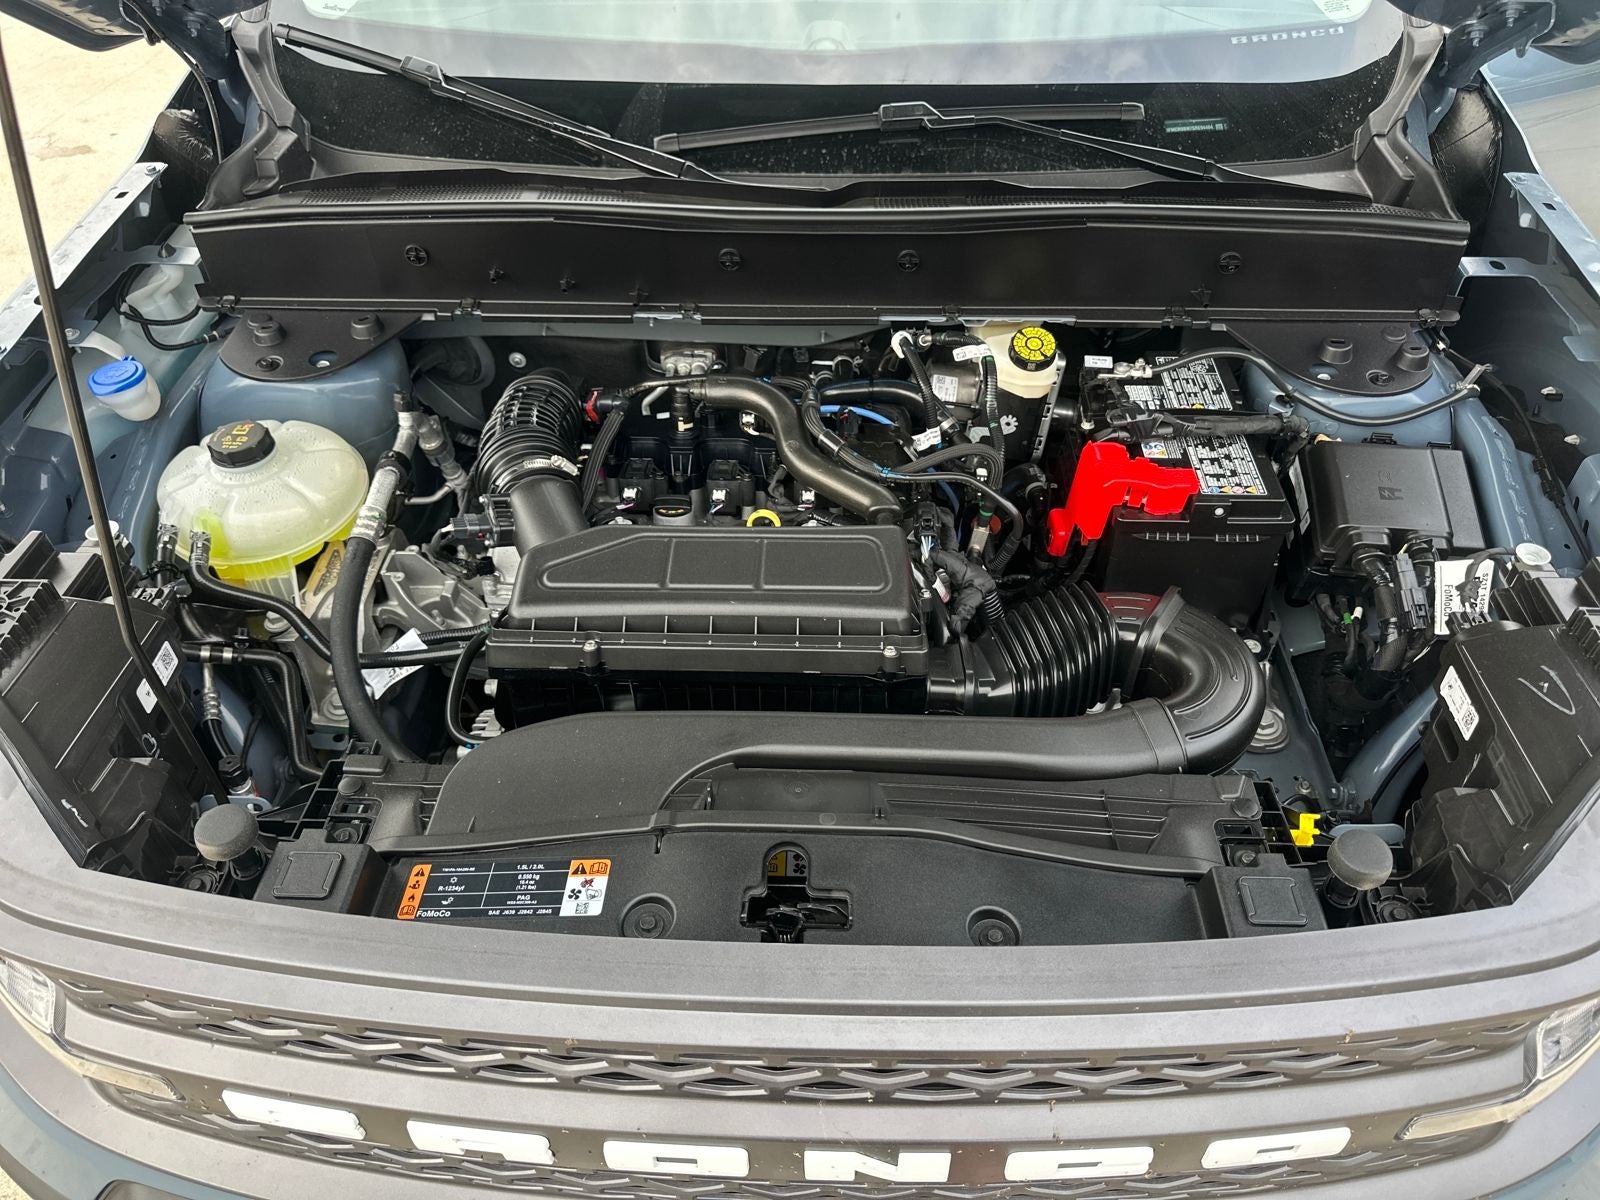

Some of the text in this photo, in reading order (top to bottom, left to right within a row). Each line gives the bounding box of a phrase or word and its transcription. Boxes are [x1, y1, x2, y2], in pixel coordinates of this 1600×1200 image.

[1230, 26, 1344, 44] BRONCO
[1443, 584, 1454, 617] FoMoCo
[416, 910, 451, 918] FoMoCo
